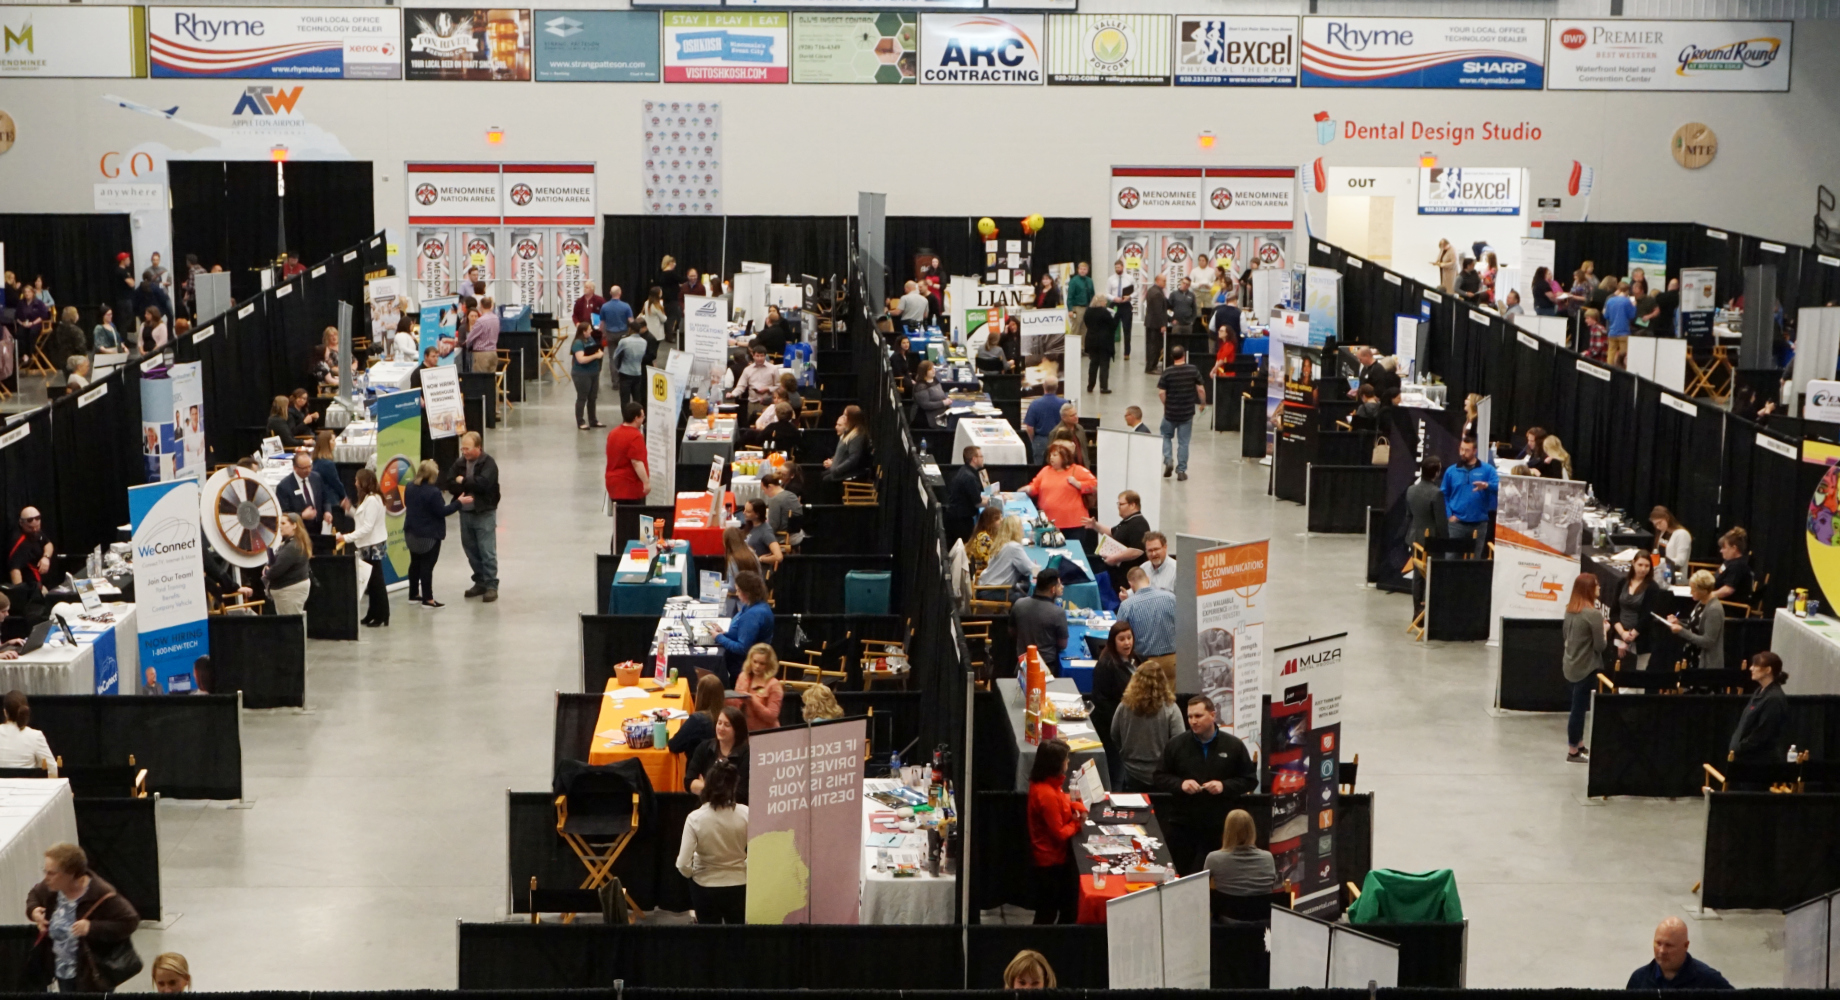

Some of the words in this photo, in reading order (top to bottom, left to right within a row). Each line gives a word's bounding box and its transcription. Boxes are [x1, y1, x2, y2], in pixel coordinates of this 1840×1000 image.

[672, 15, 700, 25] STAY
[715, 16, 743, 25] PLAY
[759, 16, 780, 25] EAT
[1094, 20, 1127, 31] VALLEY
[174, 13, 265, 42] Rhyme
[1326, 22, 1414, 51] Rhyme
[1563, 34, 1585, 44] BWP
[1592, 26, 1664, 45] PREMIER
[418, 36, 438, 46] FOX
[439, 36, 470, 49] RIVER
[683, 37, 722, 53] OSHKOSH
[939, 38, 1025, 66] ARC
[1227, 34, 1292, 65] excel
[271, 65, 341, 74] www.rhymebiz.com
[549, 61, 646, 69] www.strangpatteson.com
[1089, 57, 1130, 71] POPCORN
[1462, 62, 1527, 73] SHARP
[685, 67, 767, 79] VISITOSHKOSH.COM
[925, 69, 1039, 81] CONTRACTING
[1578, 75, 1624, 83] Convention
[1625, 75, 1651, 83] Center
[1459, 77, 1526, 85] www.rhymebiz.com
[232, 86, 305, 115] ATW
[1344, 120, 1404, 140] Dental
[1412, 121, 1475, 145] Design
[1482, 121, 1542, 141] Studio
[1348, 178, 1377, 188] OUT
[1462, 177, 1510, 200] excel
[100, 188, 157, 197] anywhere
[535, 187, 591, 195] MENOMINEE
[1143, 191, 1197, 199] MENOMINEE
[1235, 191, 1289, 199] MENOMINEE
[440, 195, 470, 203] NATION
[470, 195, 496, 203] ARENA
[977, 290, 1023, 306] LIAN
[1022, 315, 1064, 325] LUVATA
[654, 378, 665, 396] HB
[138, 538, 196, 558] WeConnect
[1201, 552, 1226, 569] JOIN
[1201, 568, 1212, 580] LSC
[1212, 559, 1264, 578] COMMUNICATIONS
[147, 576, 160, 587] Join
[161, 574, 174, 584] Our
[174, 569, 194, 581] Team!
[1201, 578, 1222, 590] TODAY!
[1213, 597, 1234, 607] VALUABLE
[1202, 606, 1228, 617] EXPERIENCE
[144, 635, 170, 649] NOW
[174, 629, 203, 641] HIRING
[1300, 648, 1341, 668] MUZA
